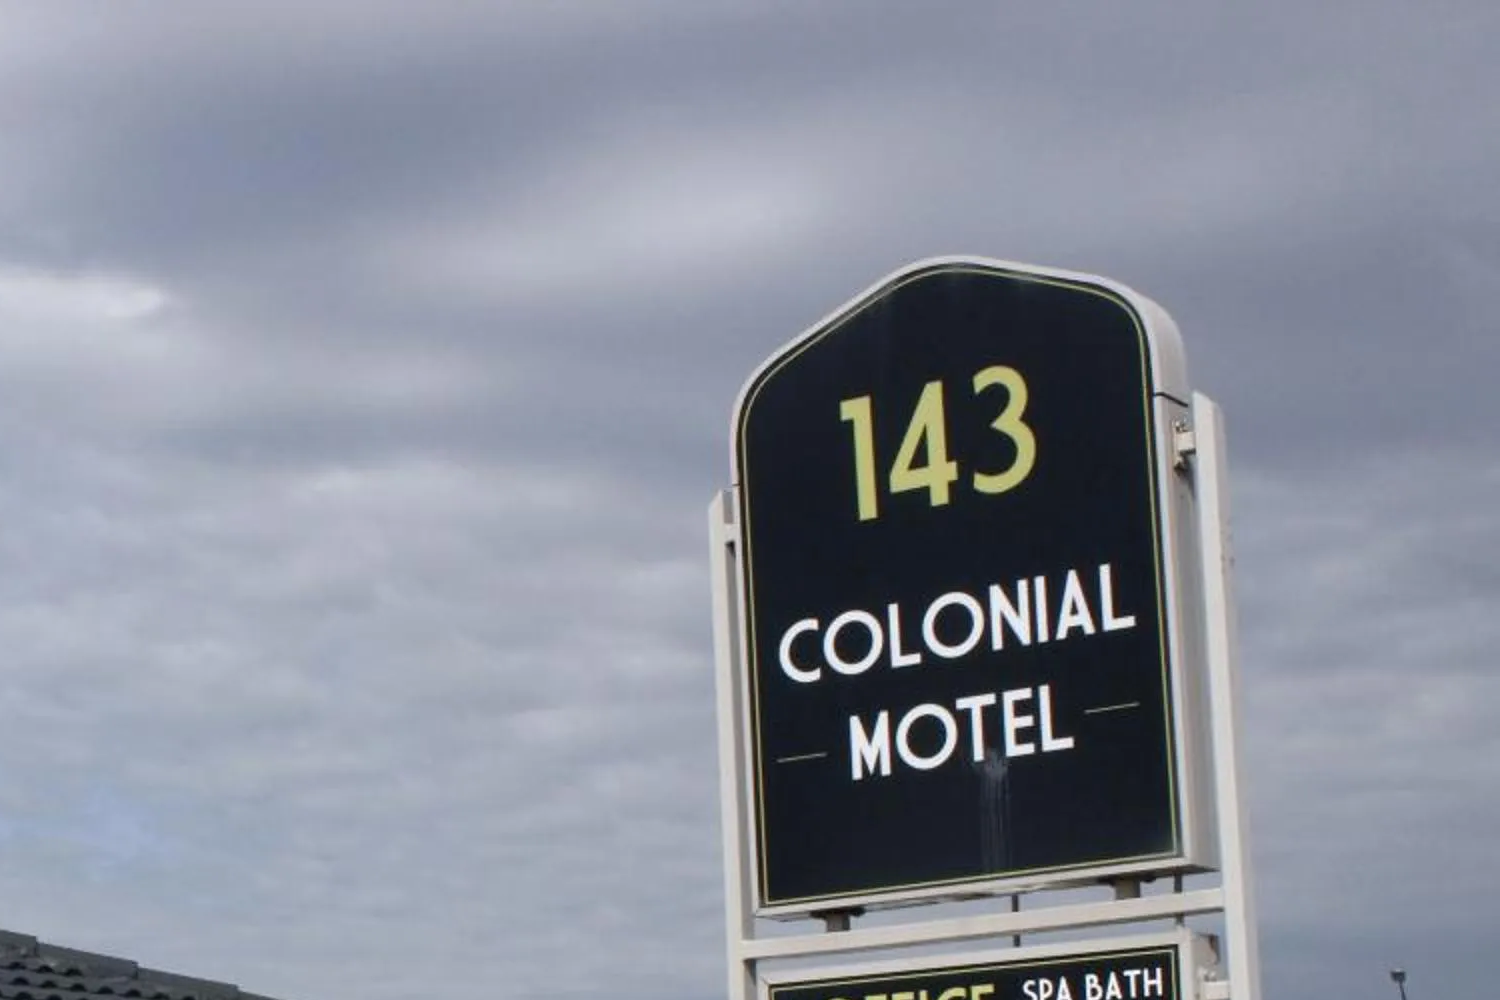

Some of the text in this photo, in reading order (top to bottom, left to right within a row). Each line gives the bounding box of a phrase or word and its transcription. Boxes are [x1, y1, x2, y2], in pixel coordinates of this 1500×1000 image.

[839, 365, 1037, 521] 143
[778, 563, 1137, 683] COLONIAL
[849, 684, 1075, 781] MOTEL
